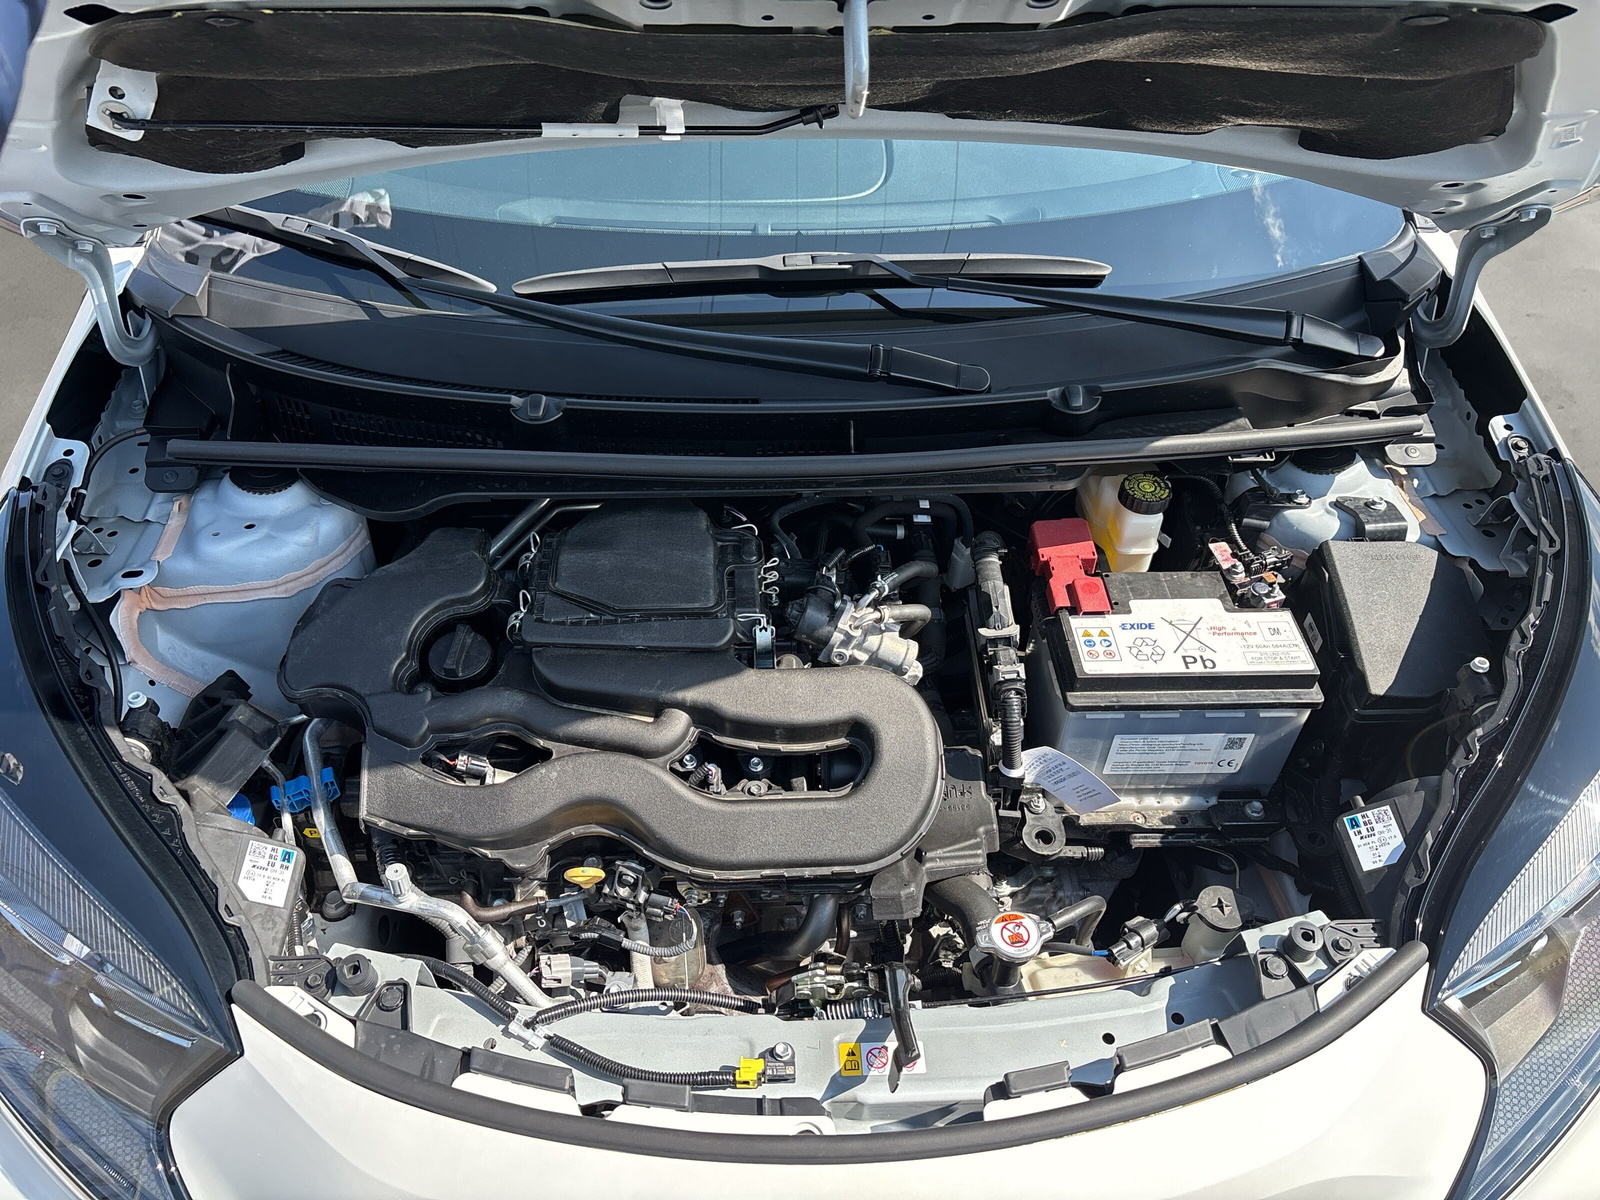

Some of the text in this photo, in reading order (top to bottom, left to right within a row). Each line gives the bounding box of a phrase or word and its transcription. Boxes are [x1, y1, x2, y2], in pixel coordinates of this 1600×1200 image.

[1120, 622, 1155, 630] EXIDE
[1181, 655, 1217, 670] Pb
[1217, 759, 1236, 768] CE
[1350, 817, 1360, 829] A
[282, 851, 290, 863] A
[280, 863, 289, 871] RH
